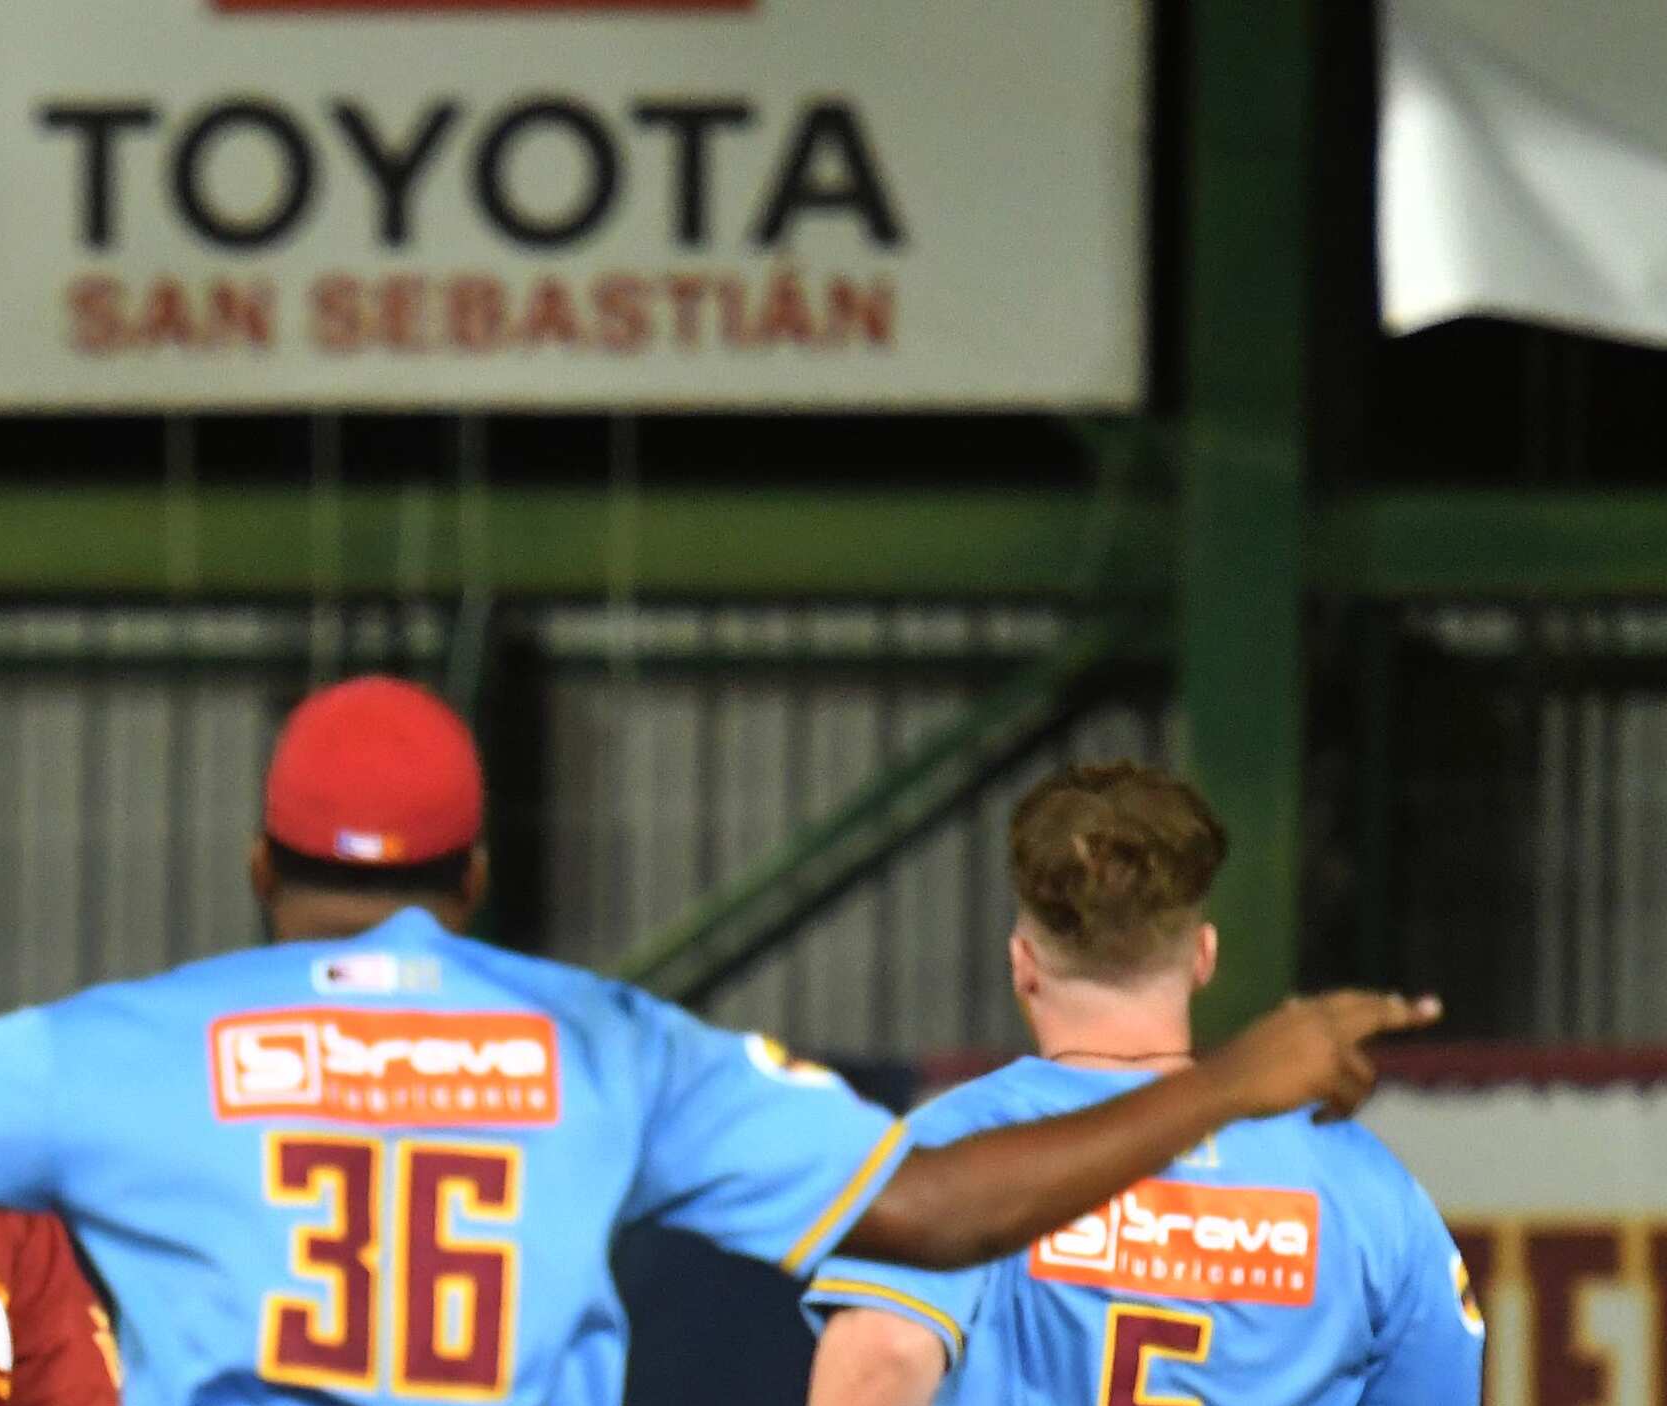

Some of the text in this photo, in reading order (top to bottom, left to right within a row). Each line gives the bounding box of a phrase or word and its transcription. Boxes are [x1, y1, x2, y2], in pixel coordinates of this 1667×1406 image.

[37, 96, 905, 253] TOYOTA
[68, 256, 897, 354] SAN SEBASTIÁN
[324, 1022, 547, 1078] brava
[257, 1130, 522, 1402] 36
[1121, 1192, 1308, 1257] brava
